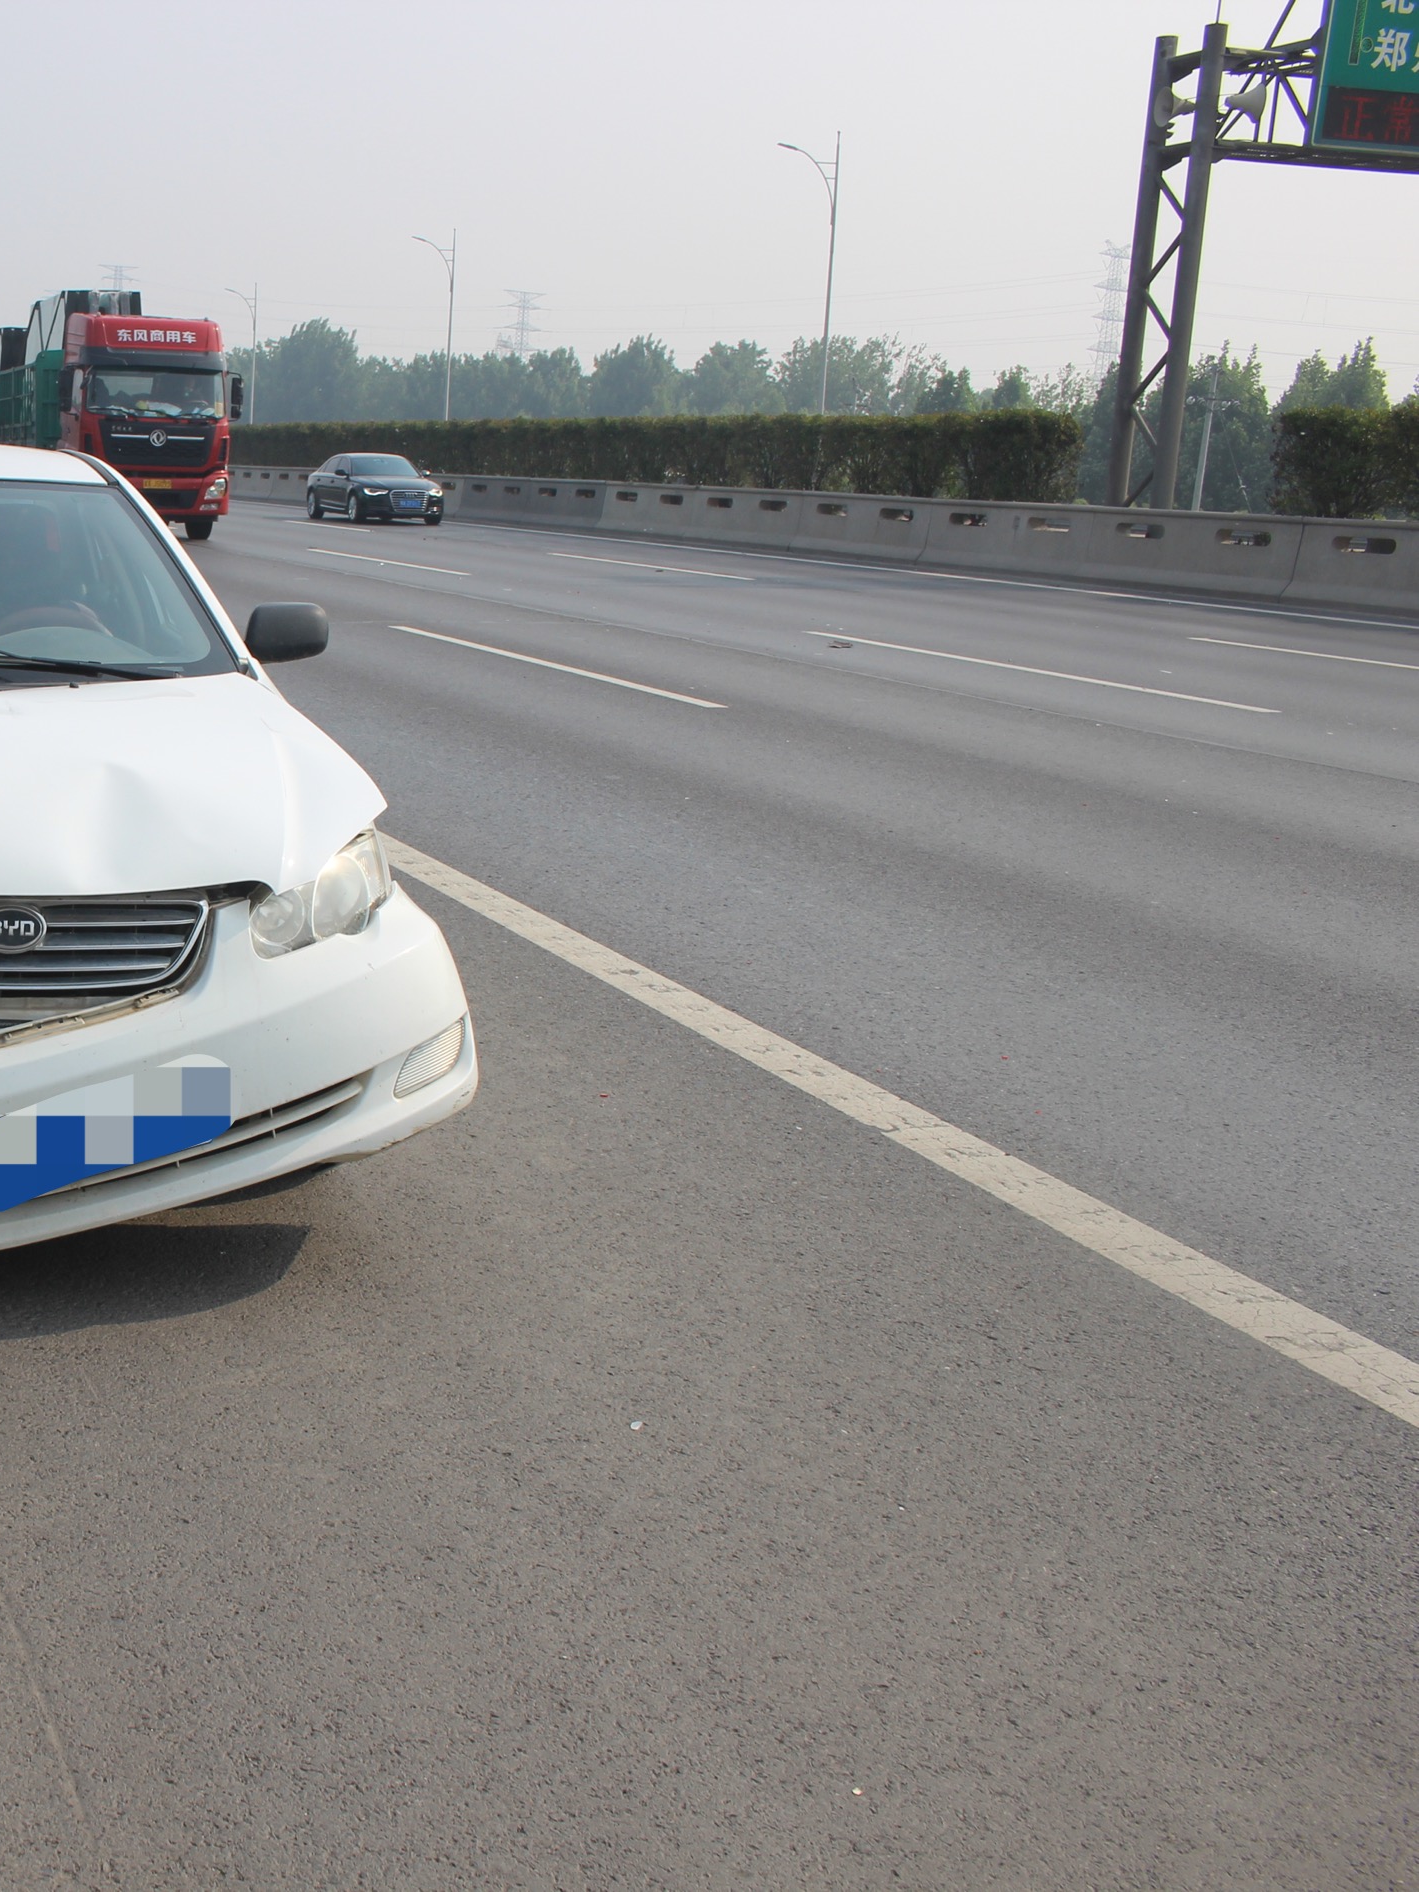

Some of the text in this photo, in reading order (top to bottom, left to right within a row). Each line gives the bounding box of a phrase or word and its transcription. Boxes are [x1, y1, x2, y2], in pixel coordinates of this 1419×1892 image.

[1371, 28, 1419, 73] 郑
[117, 329, 197, 343] 东风商用车
